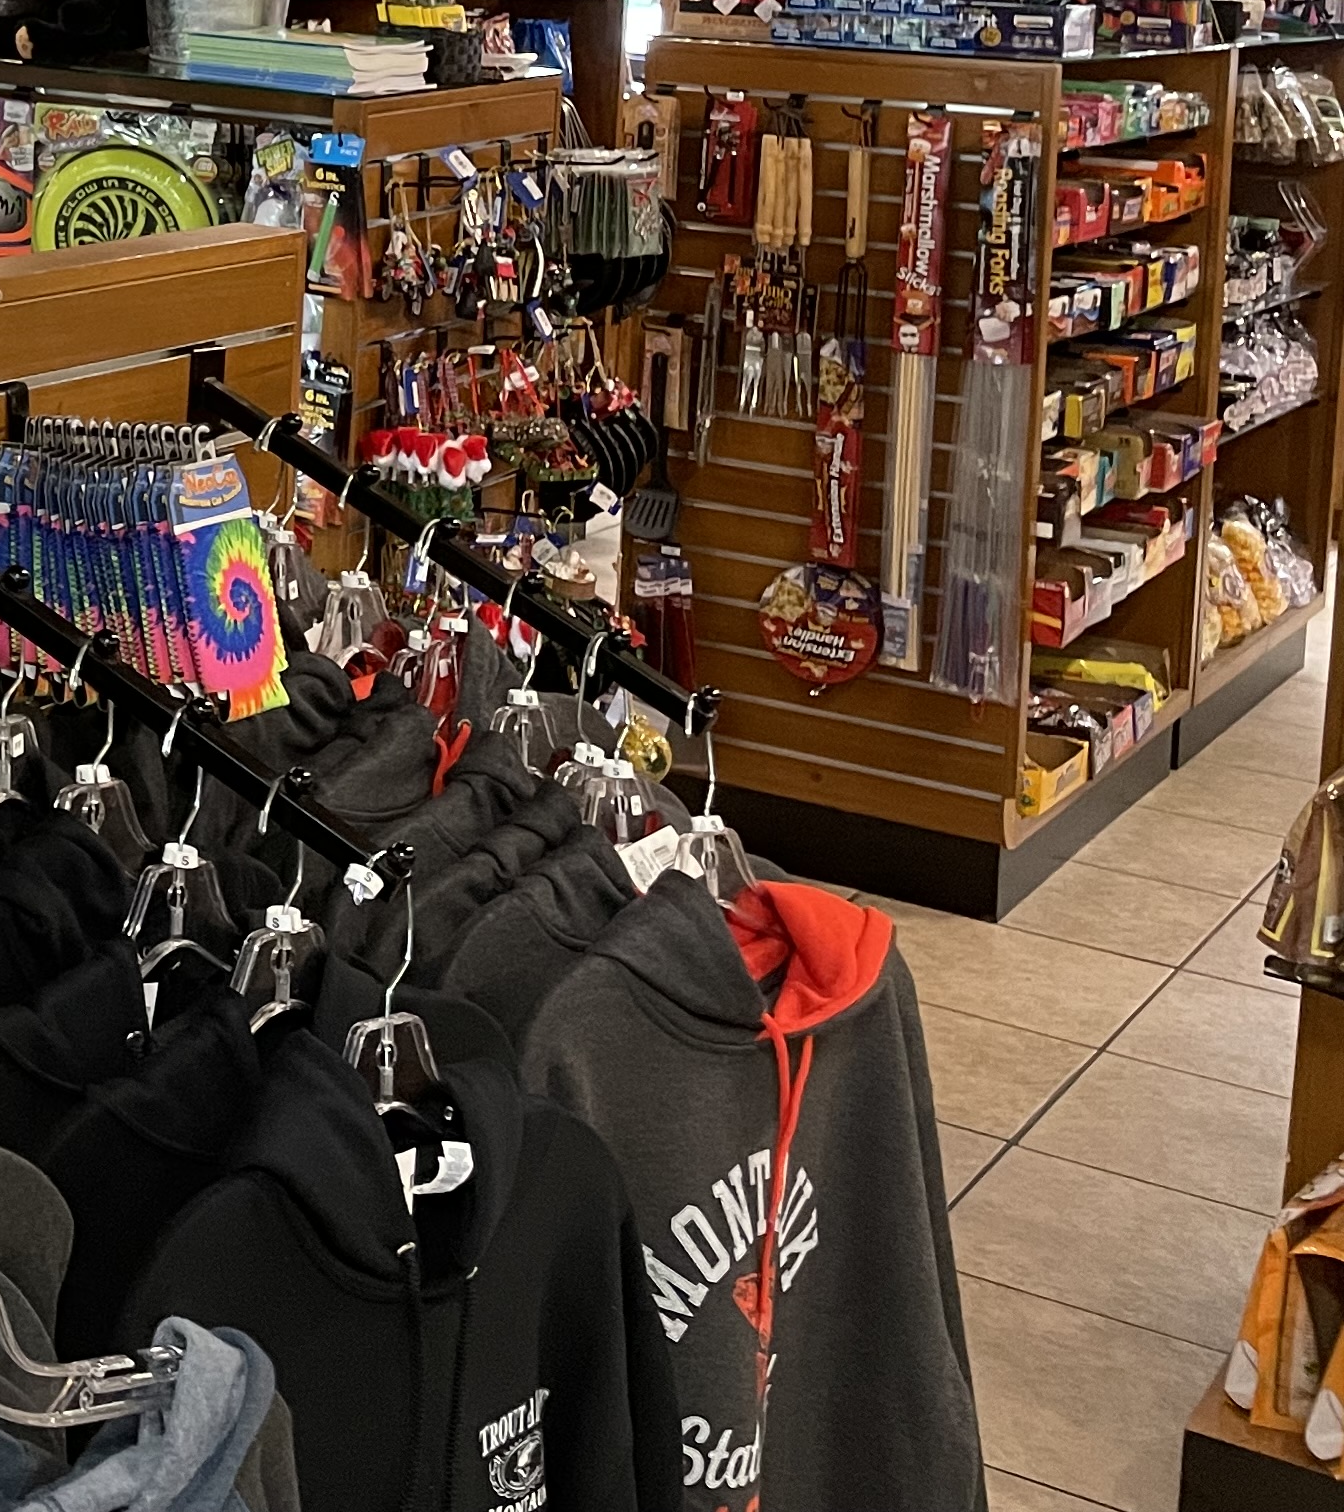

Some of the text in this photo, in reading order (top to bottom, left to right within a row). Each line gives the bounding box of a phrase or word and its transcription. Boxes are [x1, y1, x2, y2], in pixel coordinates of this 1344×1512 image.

[64, 179, 158, 216] GLOW IN THE
[915, 154, 941, 276] Marshmallow
[986, 167, 1013, 296] Roasting Forks
[182, 463, 240, 498] NeoCan
[783, 634, 856, 663] Extension
[641, 1148, 819, 1343] MONTUK
[479, 1404, 527, 1458] TROUT
